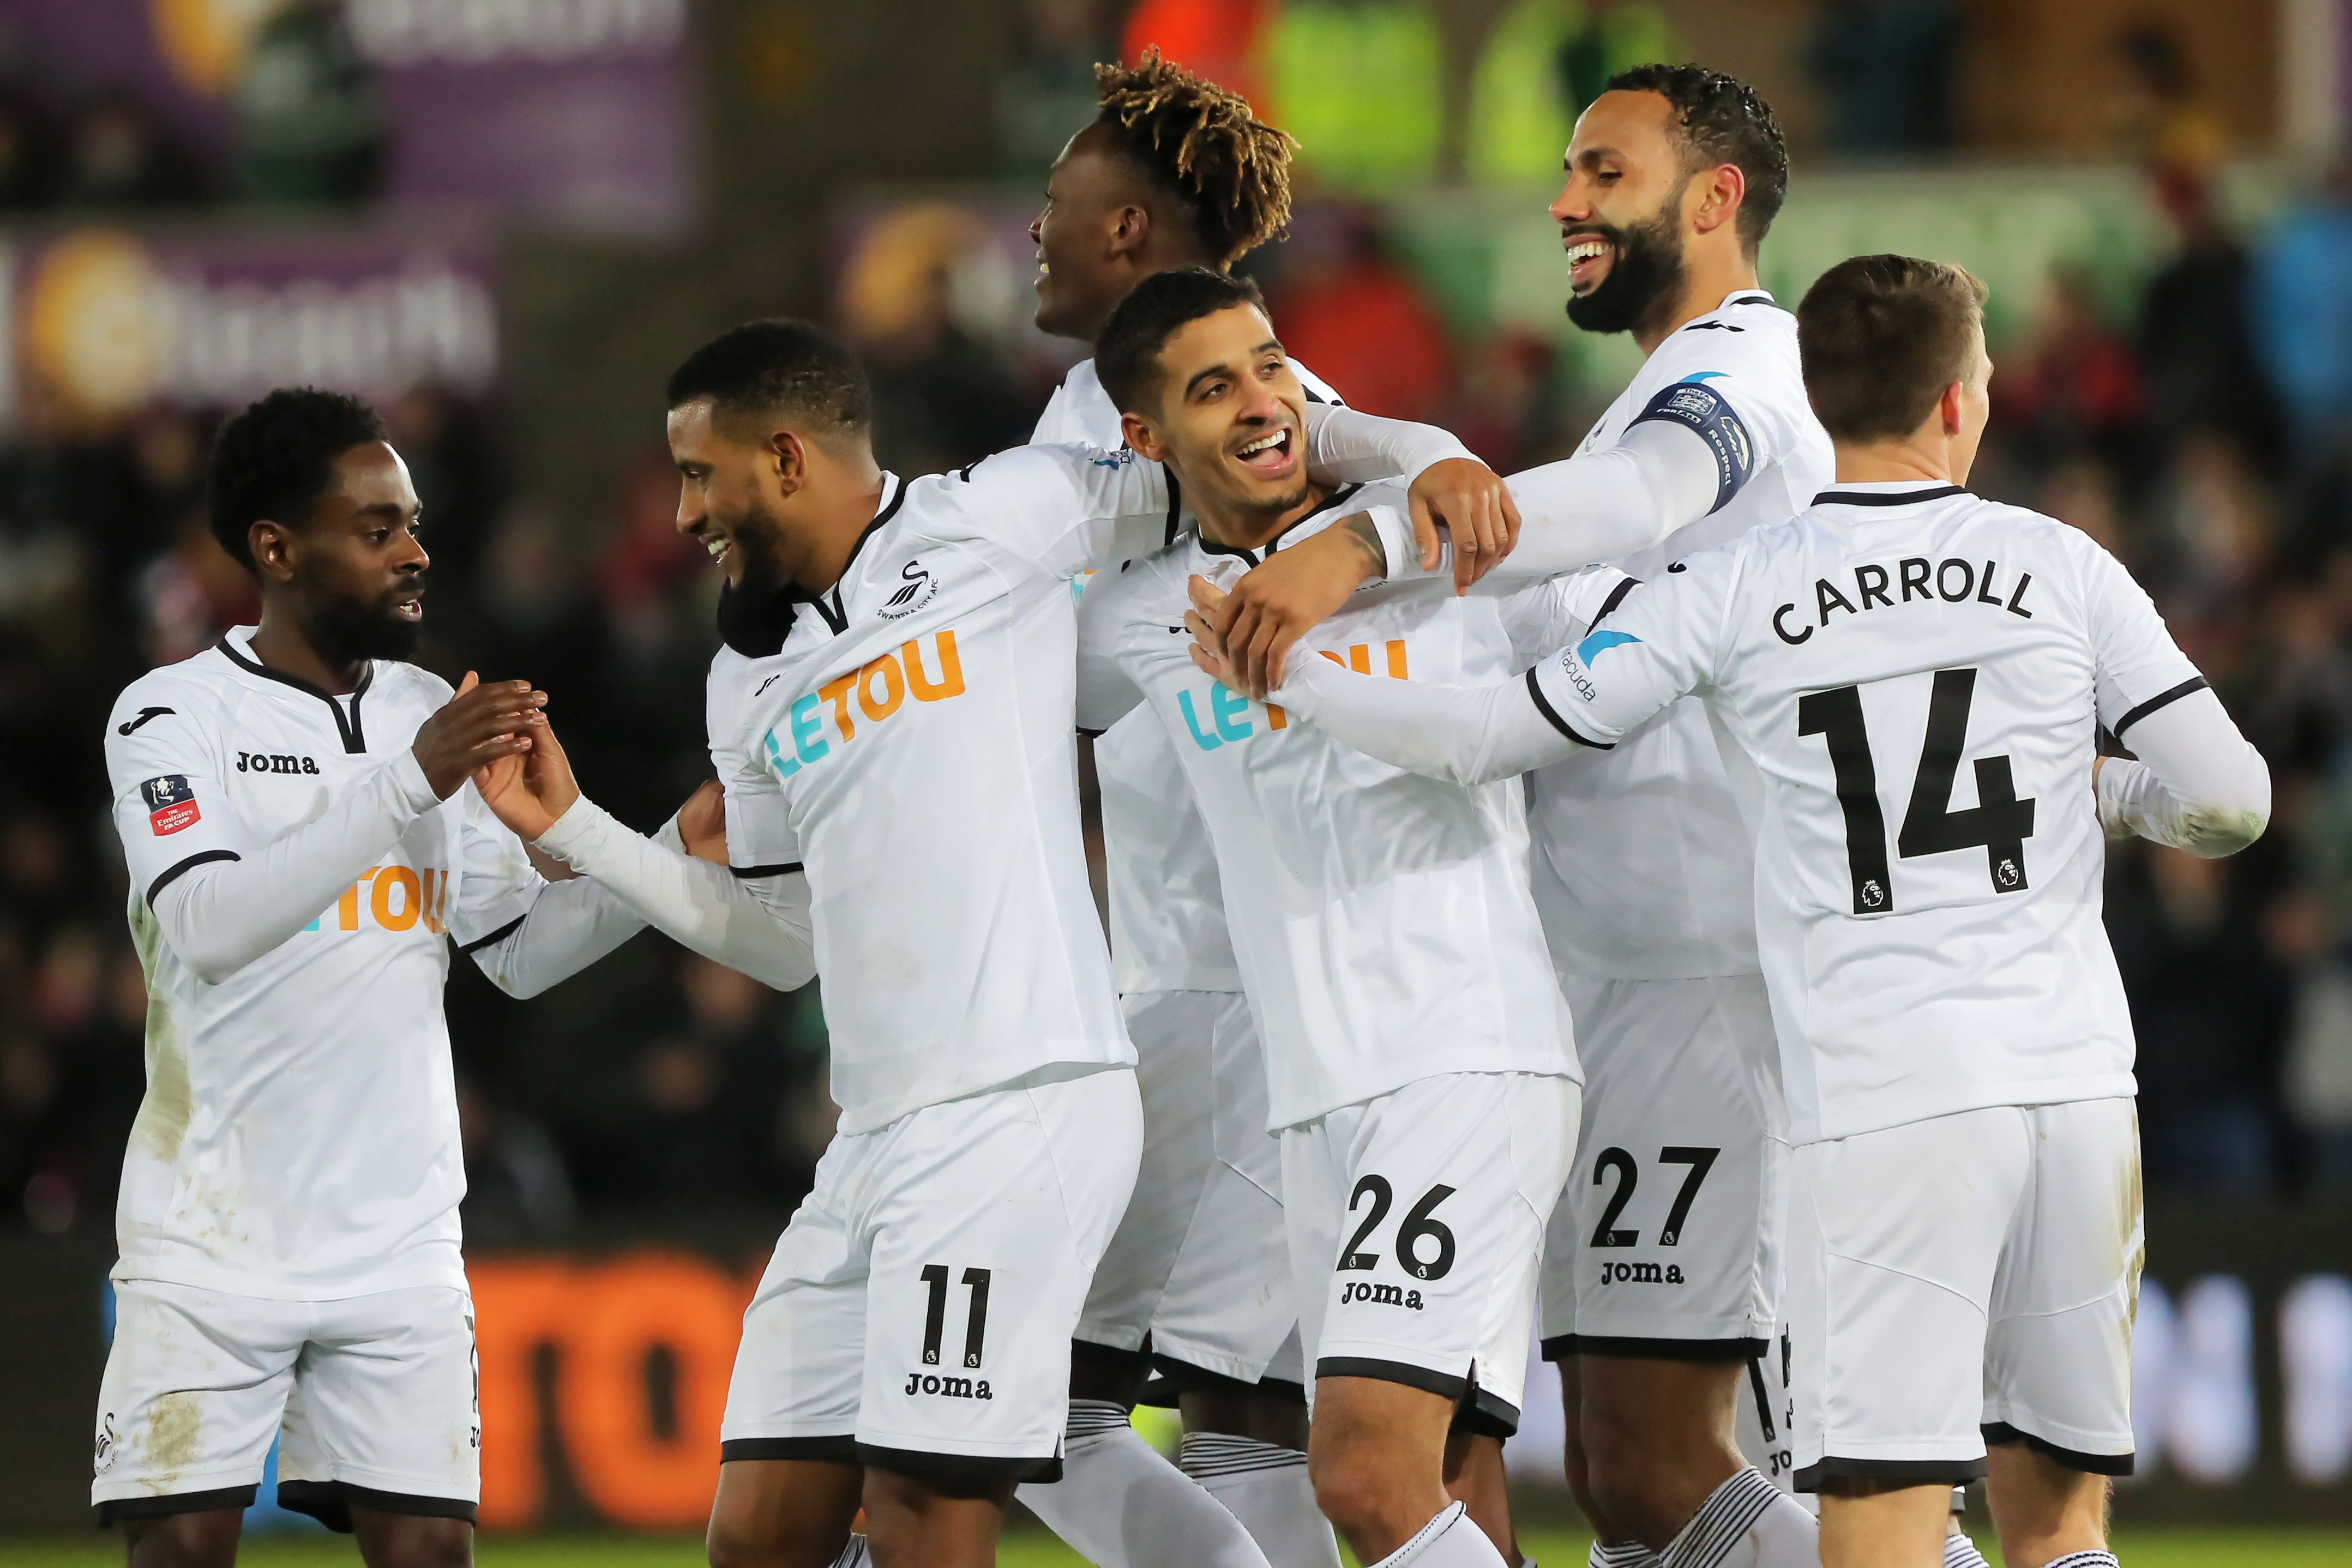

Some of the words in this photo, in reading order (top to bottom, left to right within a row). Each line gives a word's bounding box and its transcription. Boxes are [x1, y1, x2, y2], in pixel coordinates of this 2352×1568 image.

[1708, 429, 1731, 486] Respect
[877, 609, 917, 620] SWANSEA
[917, 595, 933, 609] CITY
[930, 578, 938, 595] AFC
[1773, 558, 2032, 645] CARROLL
[765, 630, 966, 779] LETOU
[157, 809, 193, 827] Emirates
[174, 817, 190, 826] CUP
[1798, 666, 2036, 915] 14
[1336, 1174, 1456, 1281] 26
[1590, 1146, 1722, 1248] 27
[920, 1264, 991, 1369] 11
